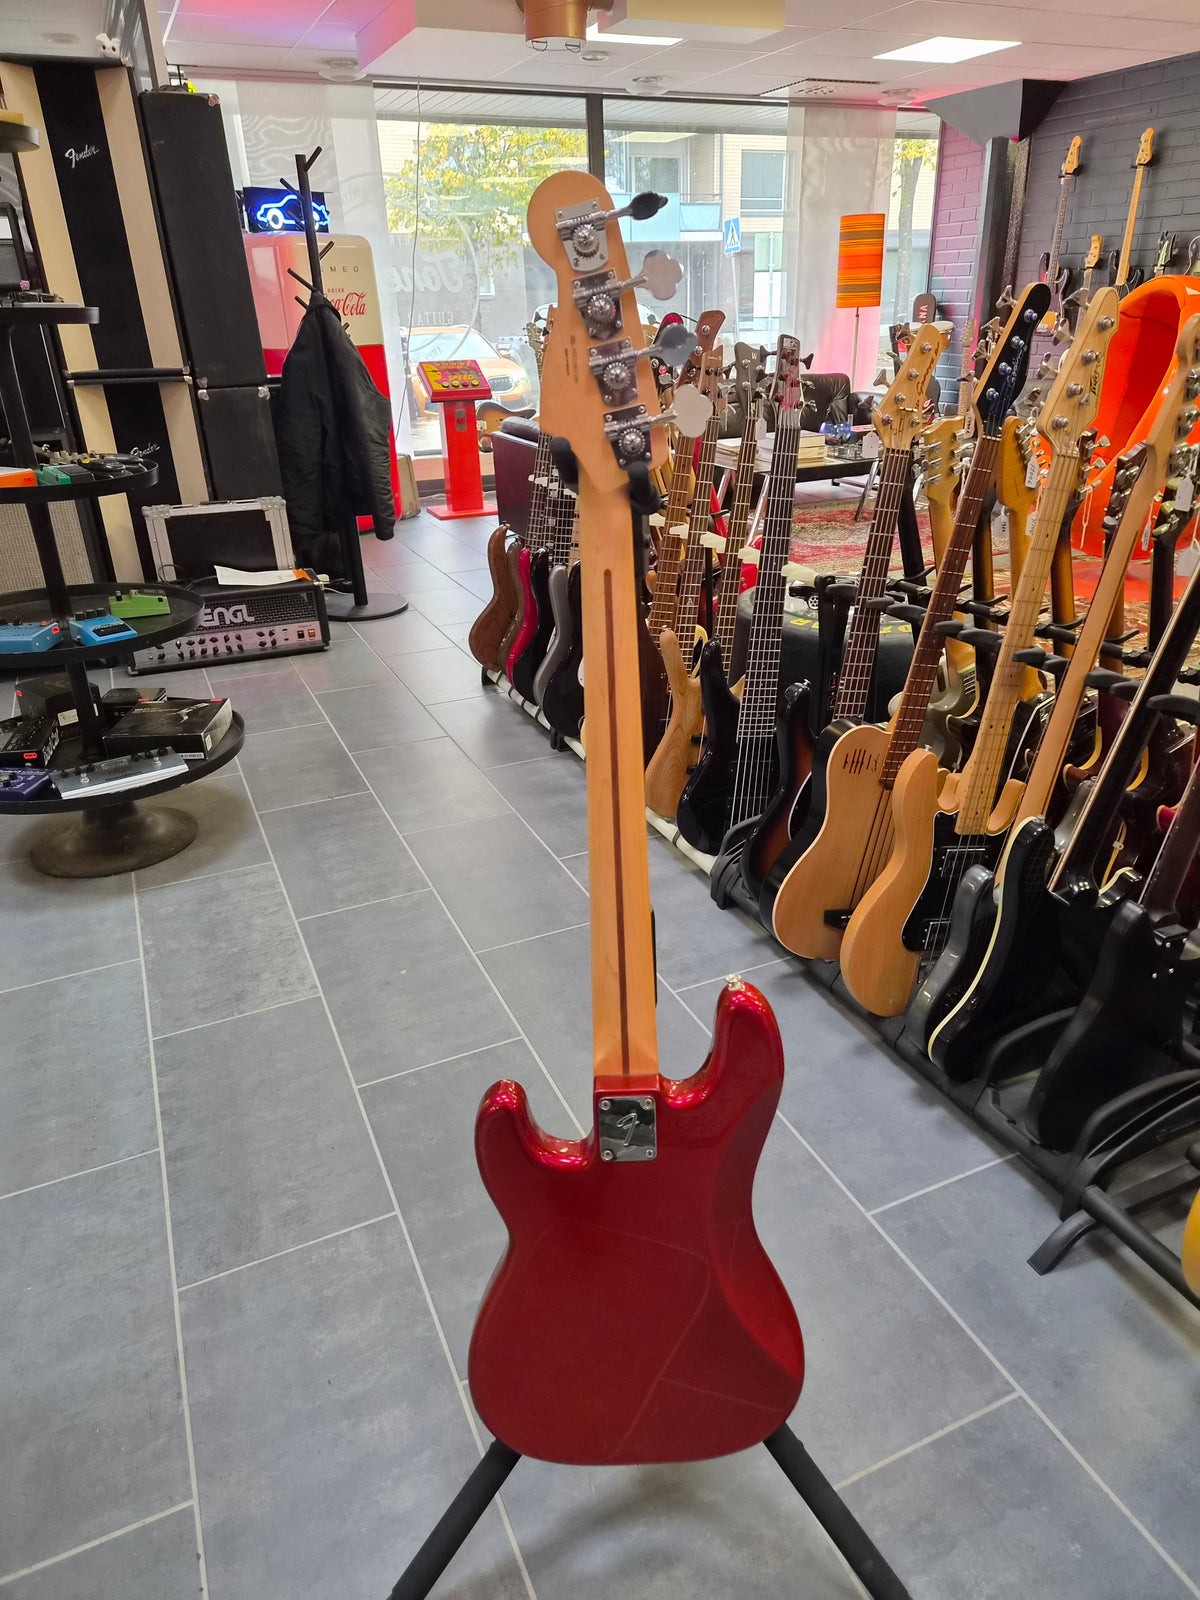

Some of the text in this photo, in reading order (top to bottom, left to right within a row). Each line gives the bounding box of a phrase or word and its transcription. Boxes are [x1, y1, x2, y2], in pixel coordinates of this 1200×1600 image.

[64, 144, 99, 168] Fender
[918, 304, 929, 323] VAN
[200, 604, 255, 627] ENGL
